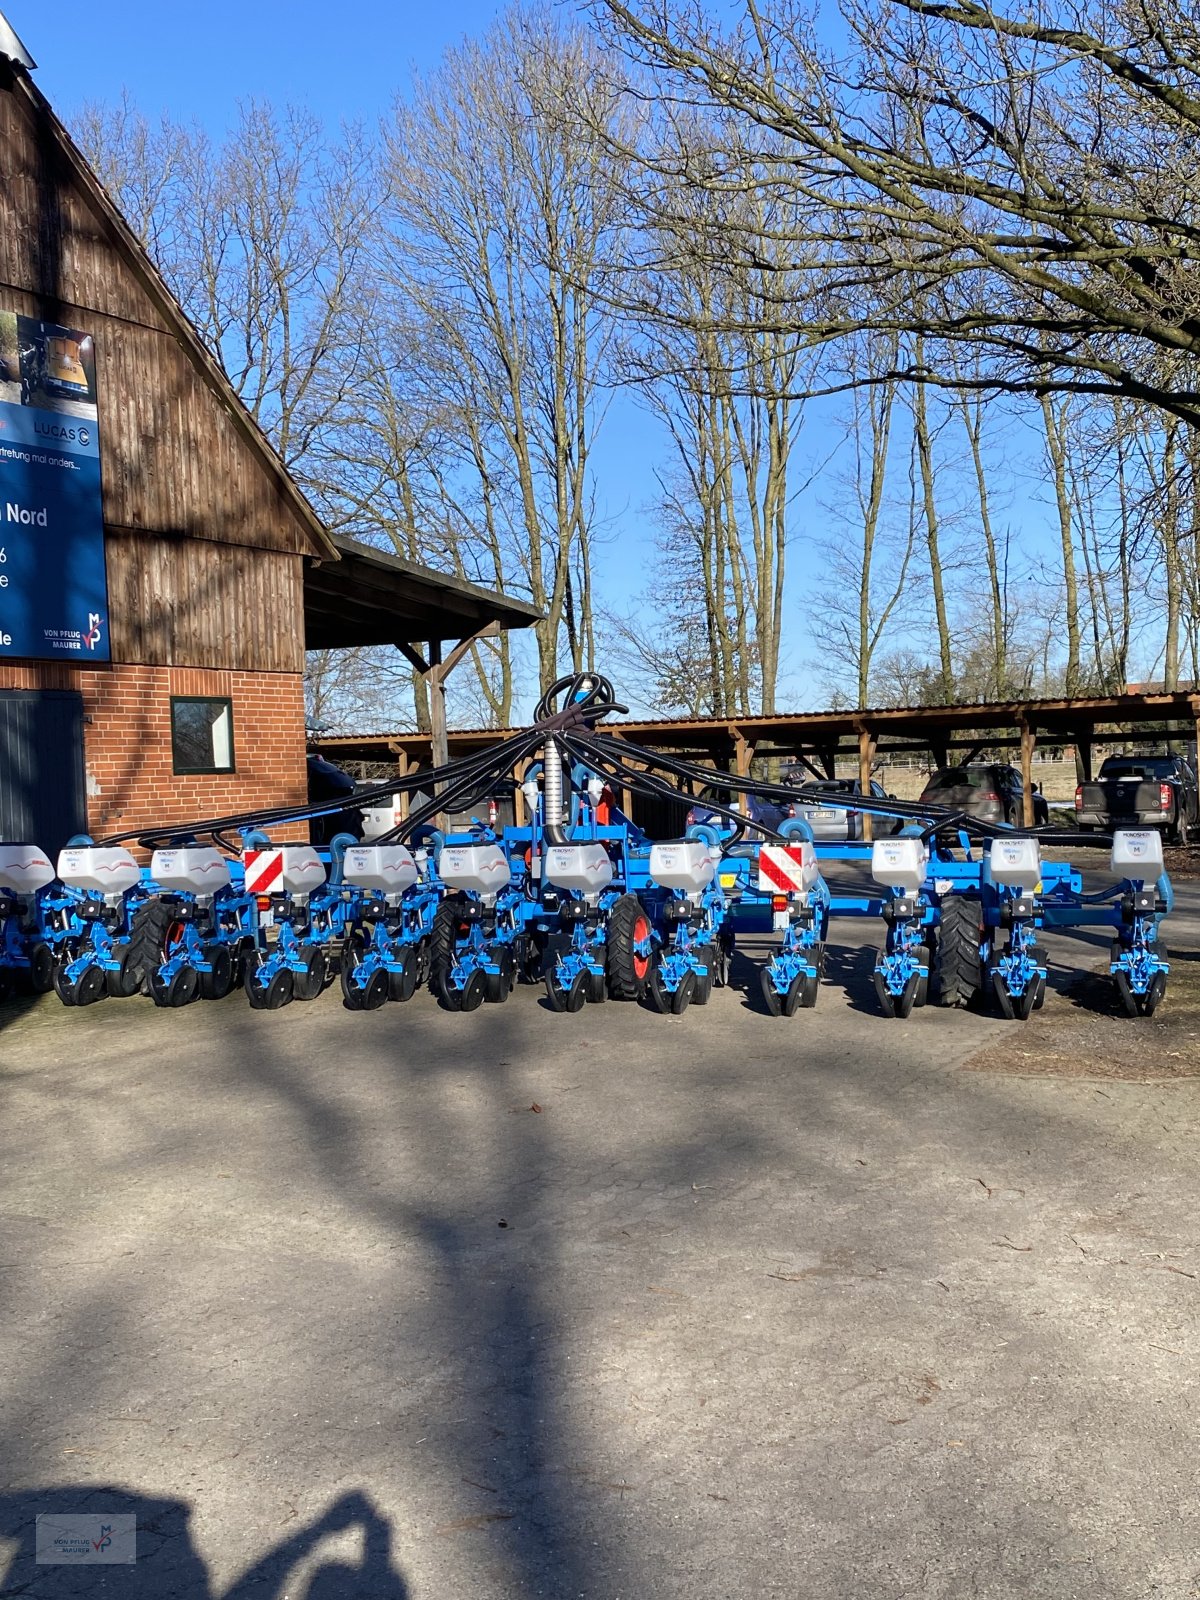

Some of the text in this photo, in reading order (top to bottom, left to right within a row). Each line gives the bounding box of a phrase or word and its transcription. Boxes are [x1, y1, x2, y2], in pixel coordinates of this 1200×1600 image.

[34, 421, 76, 440] LUCAS
[32, 454, 47, 464] mal
[6, 502, 48, 527] Nord
[44, 629, 81, 639] VON PFLUG
[52, 641, 81, 650] MAURER
